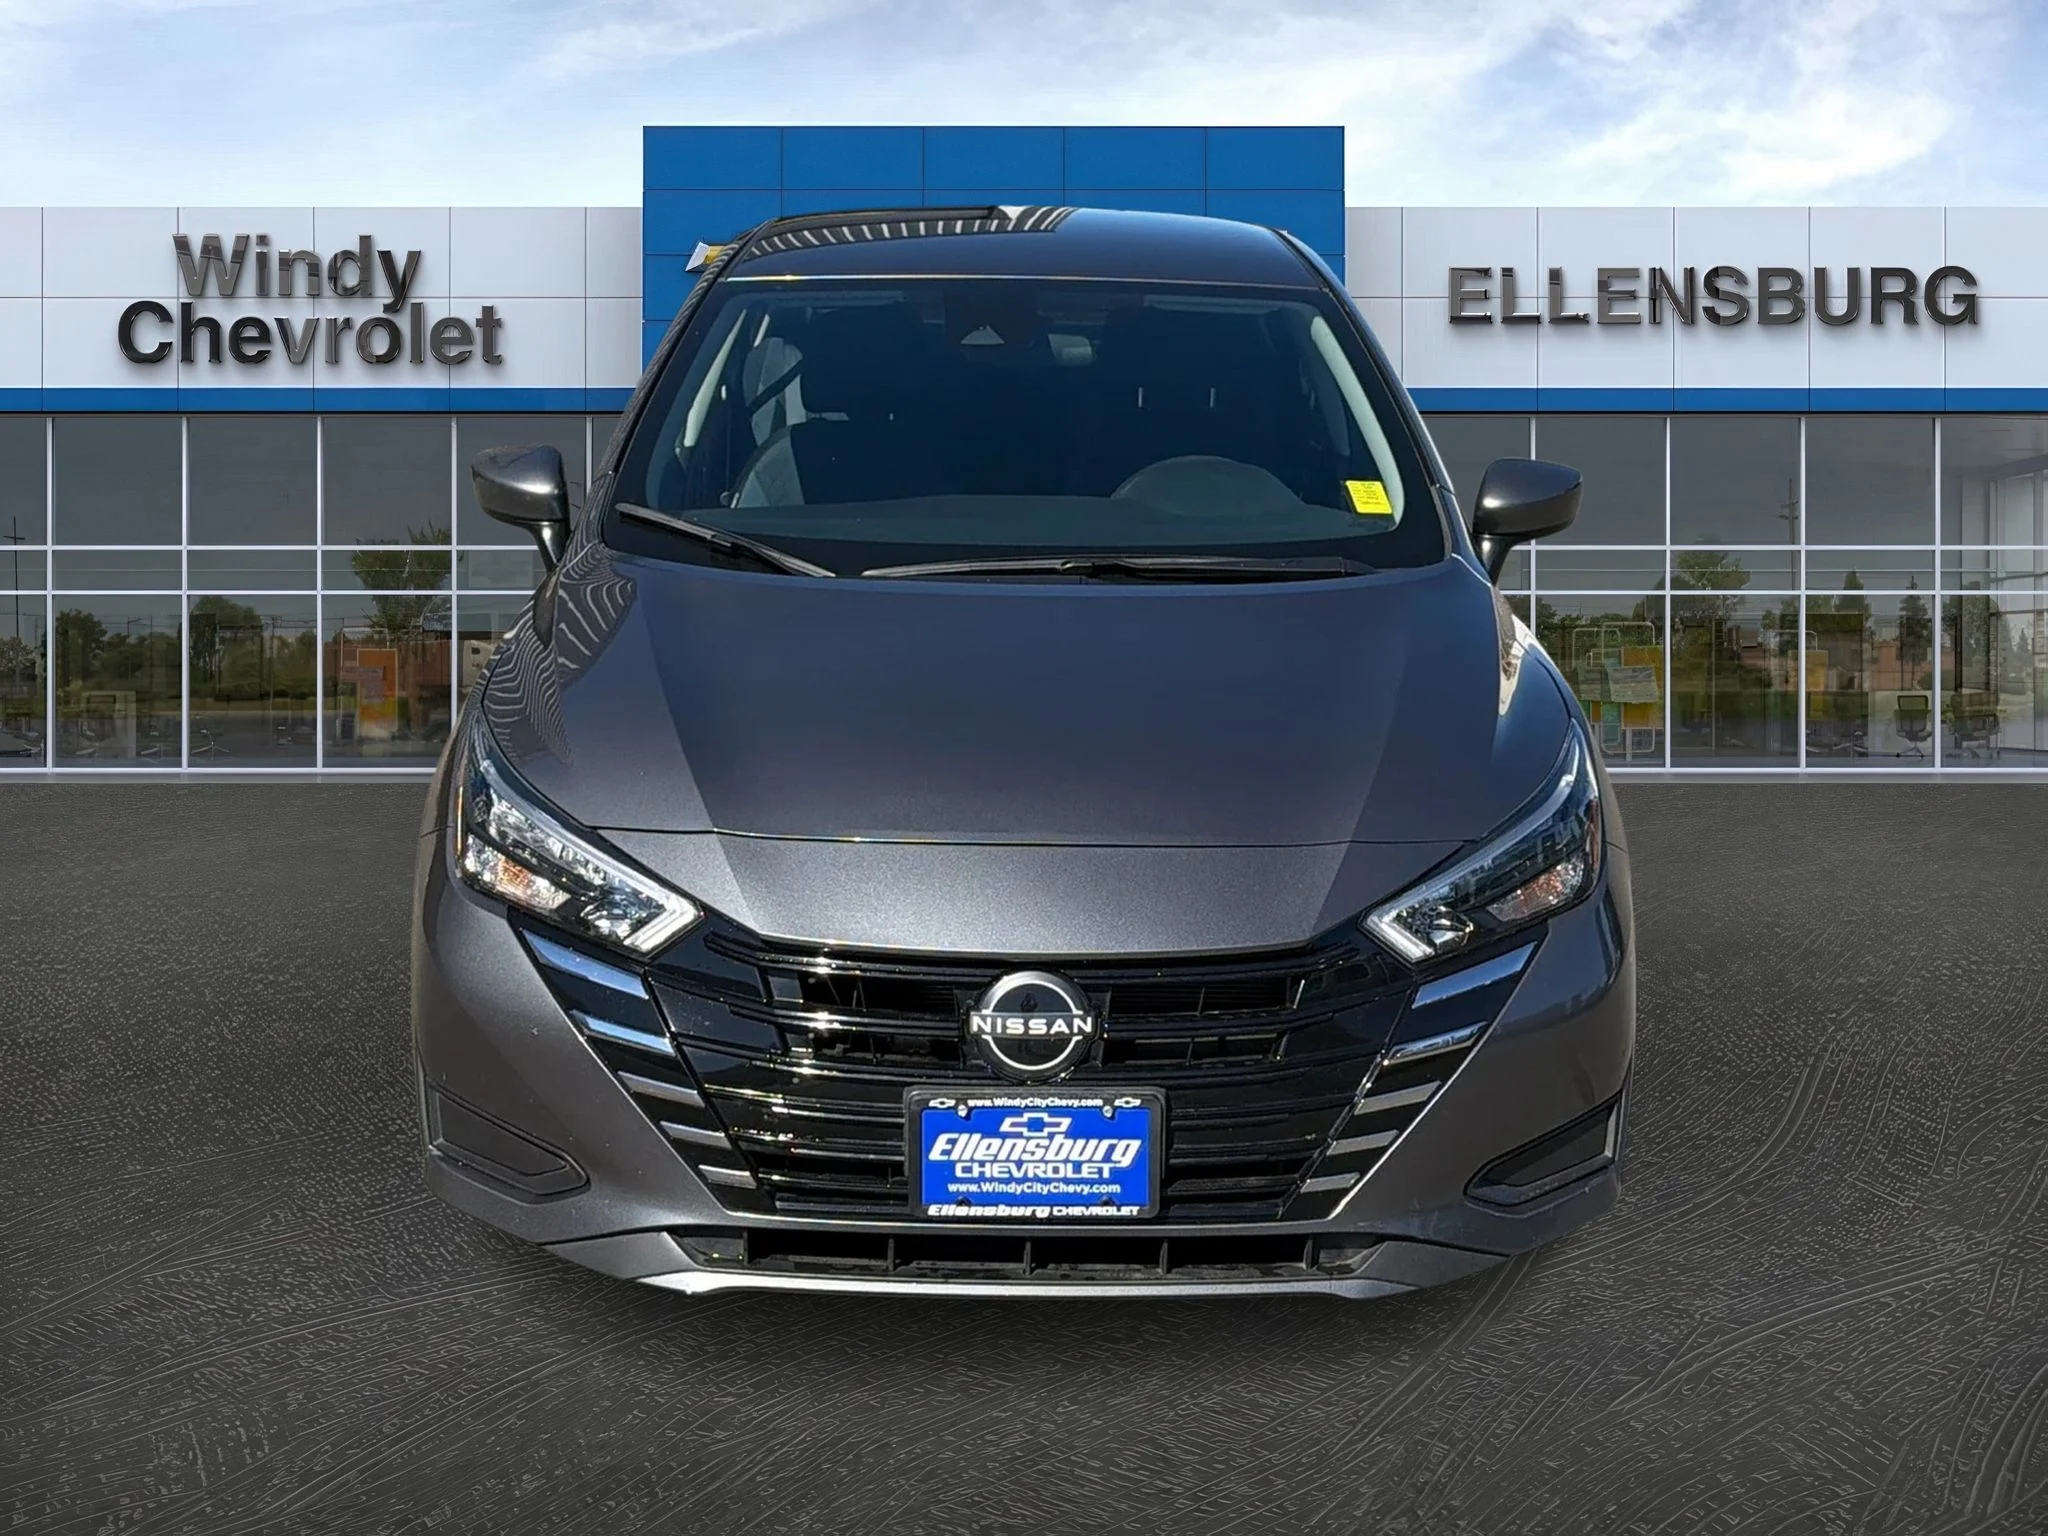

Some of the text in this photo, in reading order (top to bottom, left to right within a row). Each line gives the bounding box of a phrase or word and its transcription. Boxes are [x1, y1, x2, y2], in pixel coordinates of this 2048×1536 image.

[172, 233, 422, 312] Windy
[1448, 265, 1979, 326] ELLENSBURG
[118, 300, 503, 366] Chevrolet
[972, 1016, 1092, 1034] NISSAN
[968, 1098, 1103, 1108] www.WindyCityChevy.com
[928, 1133, 1142, 1168] Ellensburg
[955, 1162, 1113, 1179] CHEVROLET
[947, 1182, 1121, 1194] www.WindyCityChevy.com
[927, 1204, 1140, 1218] Ellensburg CHEVROLET
